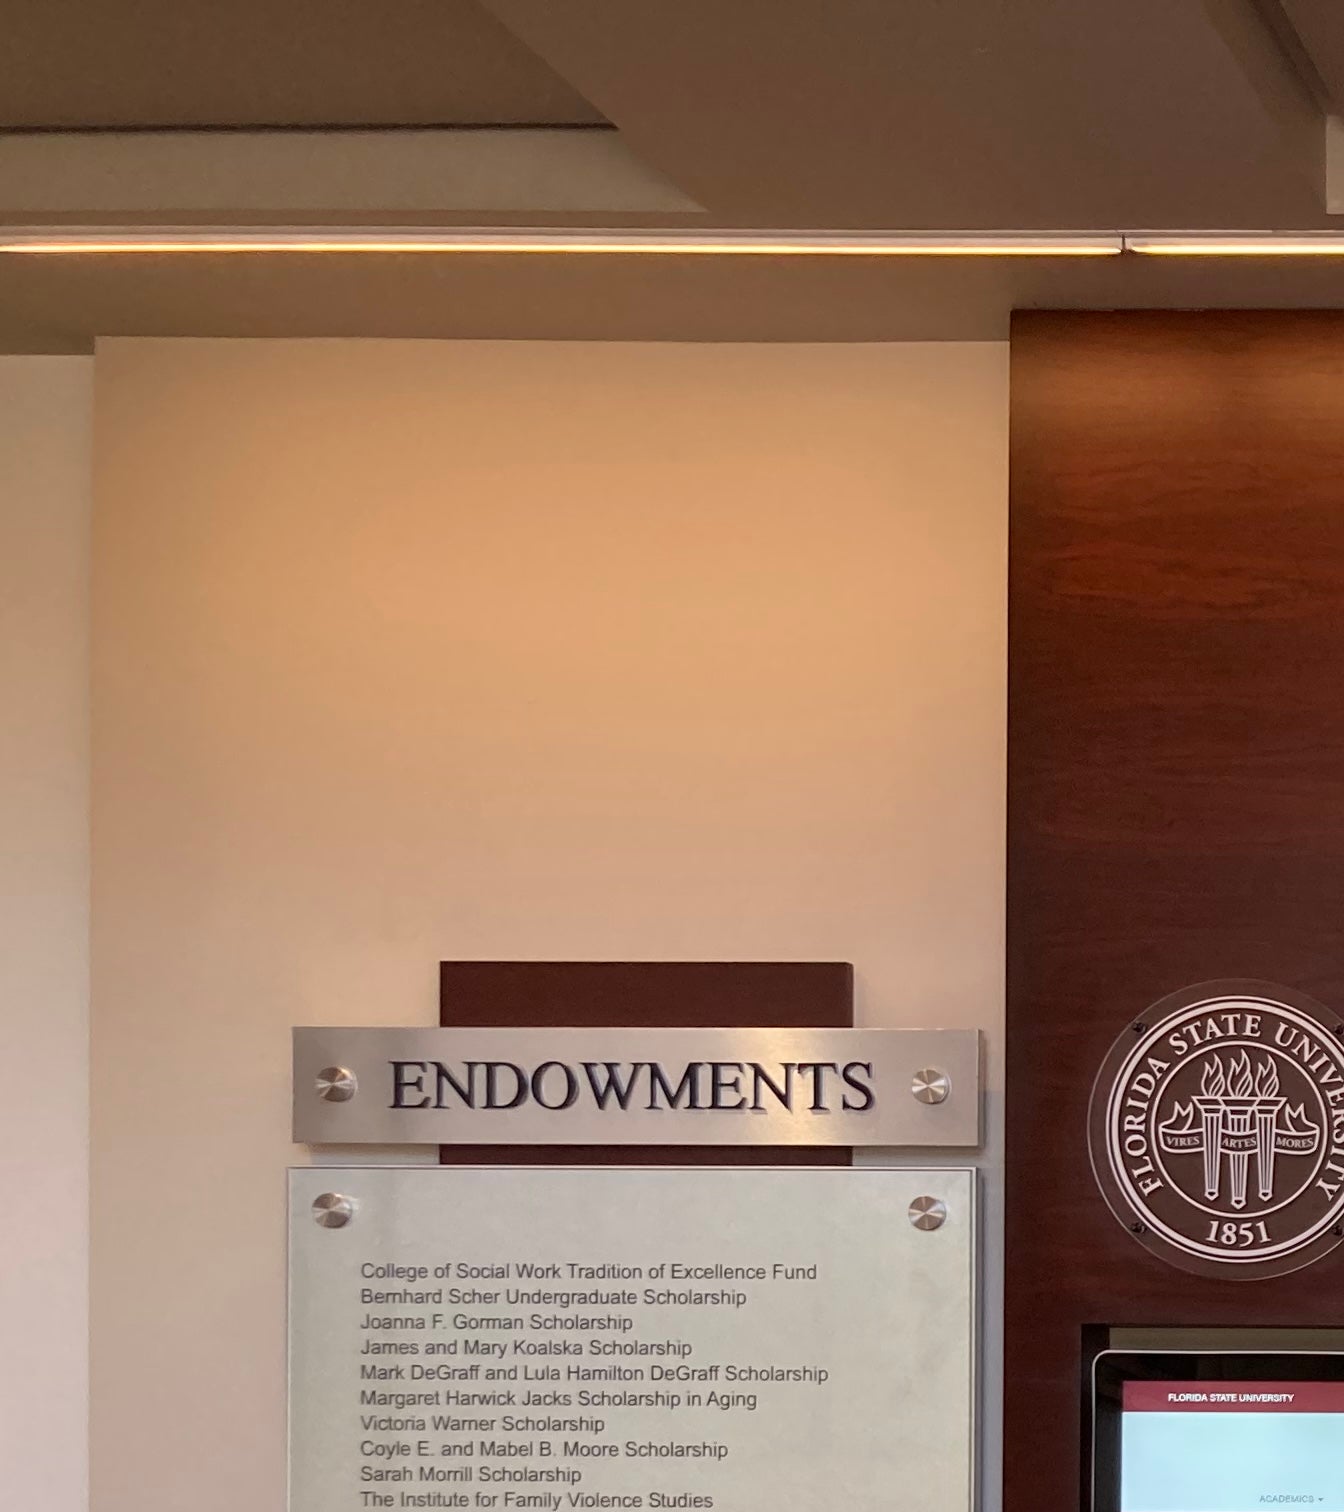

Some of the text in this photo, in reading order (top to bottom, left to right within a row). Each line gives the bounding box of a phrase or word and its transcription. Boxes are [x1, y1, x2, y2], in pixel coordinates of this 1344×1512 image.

[388, 1060, 875, 1115] ENDOWMENTS
[1124, 1056, 1170, 1196] FLORIDA
[1169, 1014, 1261, 1055] STATE
[1165, 1136, 1314, 1148] VIRES ARTES MORES
[1205, 1220, 1272, 1247] 1851
[361, 1262, 817, 1283] College of Social Work Tradition of Excellence Fund
[360, 1288, 747, 1309] Bernhard Scher Undergraduate Scholarship
[360, 1313, 633, 1334] Joanna F. Gorman Scholarship
[360, 1364, 829, 1386] Mark DeGraff and Lula Hamilton DeGraff Scholarship
[1168, 1393, 1294, 1402] FLORIDA STATE UNIVERSITY
[1259, 1494, 1314, 1503] ACADEMICS
